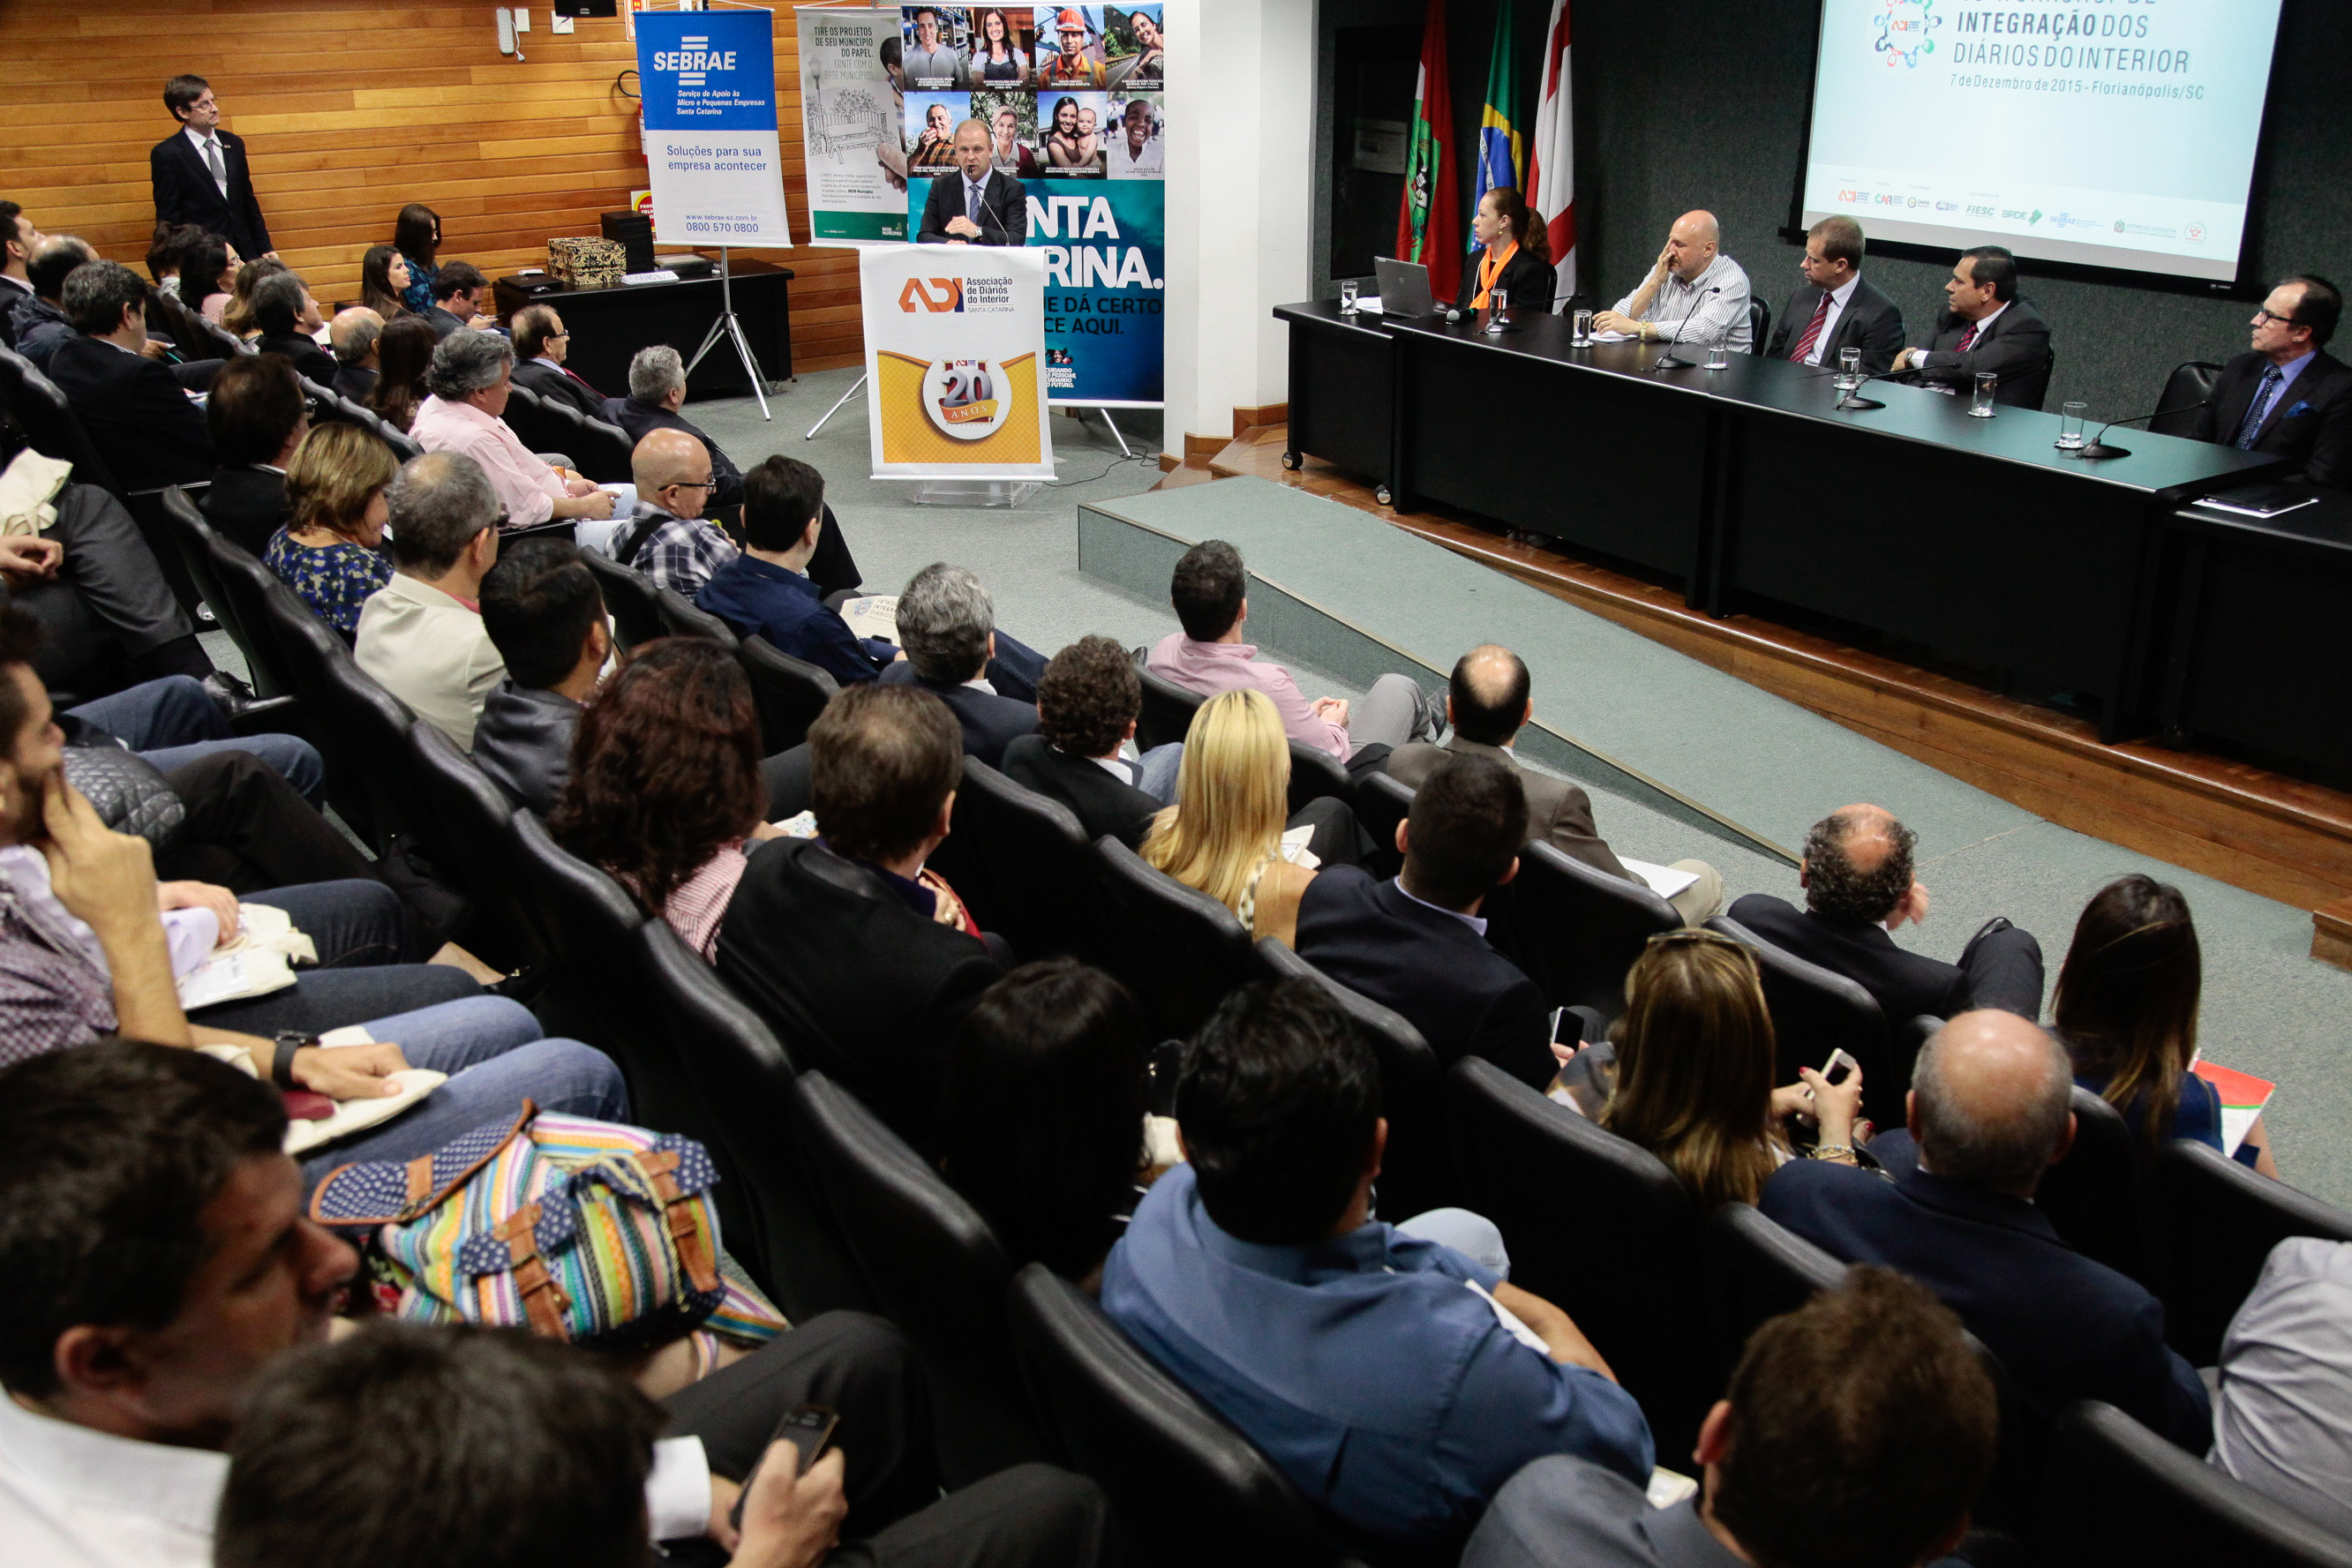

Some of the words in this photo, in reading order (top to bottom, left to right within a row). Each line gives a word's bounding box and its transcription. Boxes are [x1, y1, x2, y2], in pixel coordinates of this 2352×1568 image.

[814, 26, 828, 36] TIRE
[830, 26, 838, 36] OS
[839, 26, 873, 36] PROJETOS
[1957, 9, 2096, 41] INTEGRAÇÃO
[2100, 14, 2149, 38] DOS
[815, 37, 823, 47] DE
[824, 37, 838, 47] SEU
[838, 35, 874, 47] MUNICÍPIO
[841, 48, 851, 57] DO
[852, 48, 874, 57] PAPEL.
[1953, 38, 2039, 67] DIÁRIOS
[2043, 45, 2072, 69] DO
[2078, 47, 2190, 74] INTERIOR
[653, 50, 737, 71] SEBRAE
[834, 59, 853, 69] CONTE
[853, 59, 867, 69] COM
[868, 59, 873, 69] O
[1950, 73, 1957, 86] 7
[1957, 74, 1972, 87] de
[1973, 74, 2032, 90] Dezembro
[2033, 78, 2049, 91] de
[2050, 79, 2082, 93] 2015
[2092, 80, 2205, 101] Florianópolis/SC
[678, 90, 701, 99] Serviço
[666, 145, 712, 159] Soluções
[716, 147, 739, 158] para
[742, 147, 762, 157] sua
[668, 161, 711, 172] empresa
[714, 161, 767, 170] acontecer
[1965, 205, 1995, 217] FIESC
[2001, 209, 2027, 221] BRDE
[2049, 215, 2077, 225] SEBRAE
[686, 221, 710, 232] 0800
[712, 222, 731, 232] 570
[733, 222, 759, 233] 0800
[966, 276, 1013, 287] Associação
[898, 277, 965, 312] ADI
[979, 286, 1008, 295] Diários
[967, 295, 977, 304] do
[980, 295, 1009, 304] Interior
[1064, 293, 1092, 313] DÁ
[1096, 297, 1162, 314] CERTO
[1071, 318, 1124, 335] AQUI.
[941, 369, 993, 408] 20
[951, 405, 988, 418] ANOS
